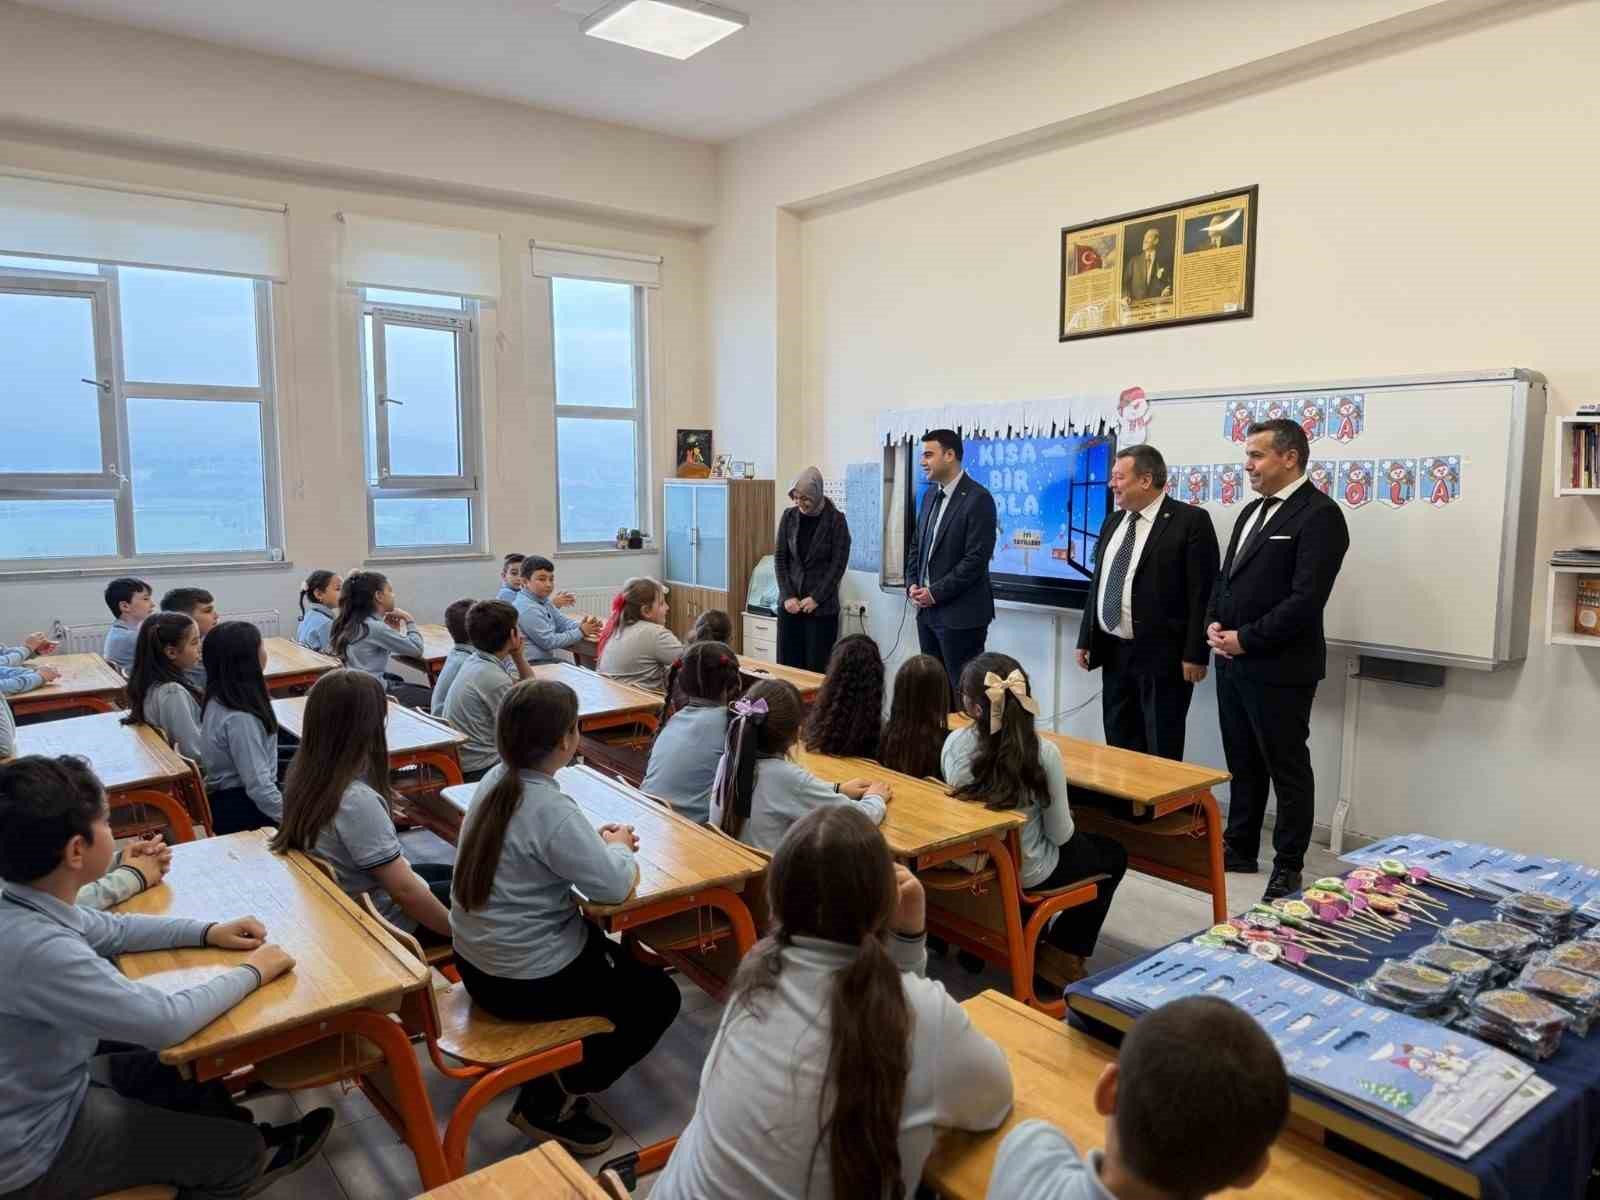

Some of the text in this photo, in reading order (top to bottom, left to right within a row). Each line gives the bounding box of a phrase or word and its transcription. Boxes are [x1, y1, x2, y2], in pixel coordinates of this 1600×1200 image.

[1231, 416, 1354, 441] KSA
[979, 442, 1036, 466] KISA
[993, 493, 1039, 514] OLA
